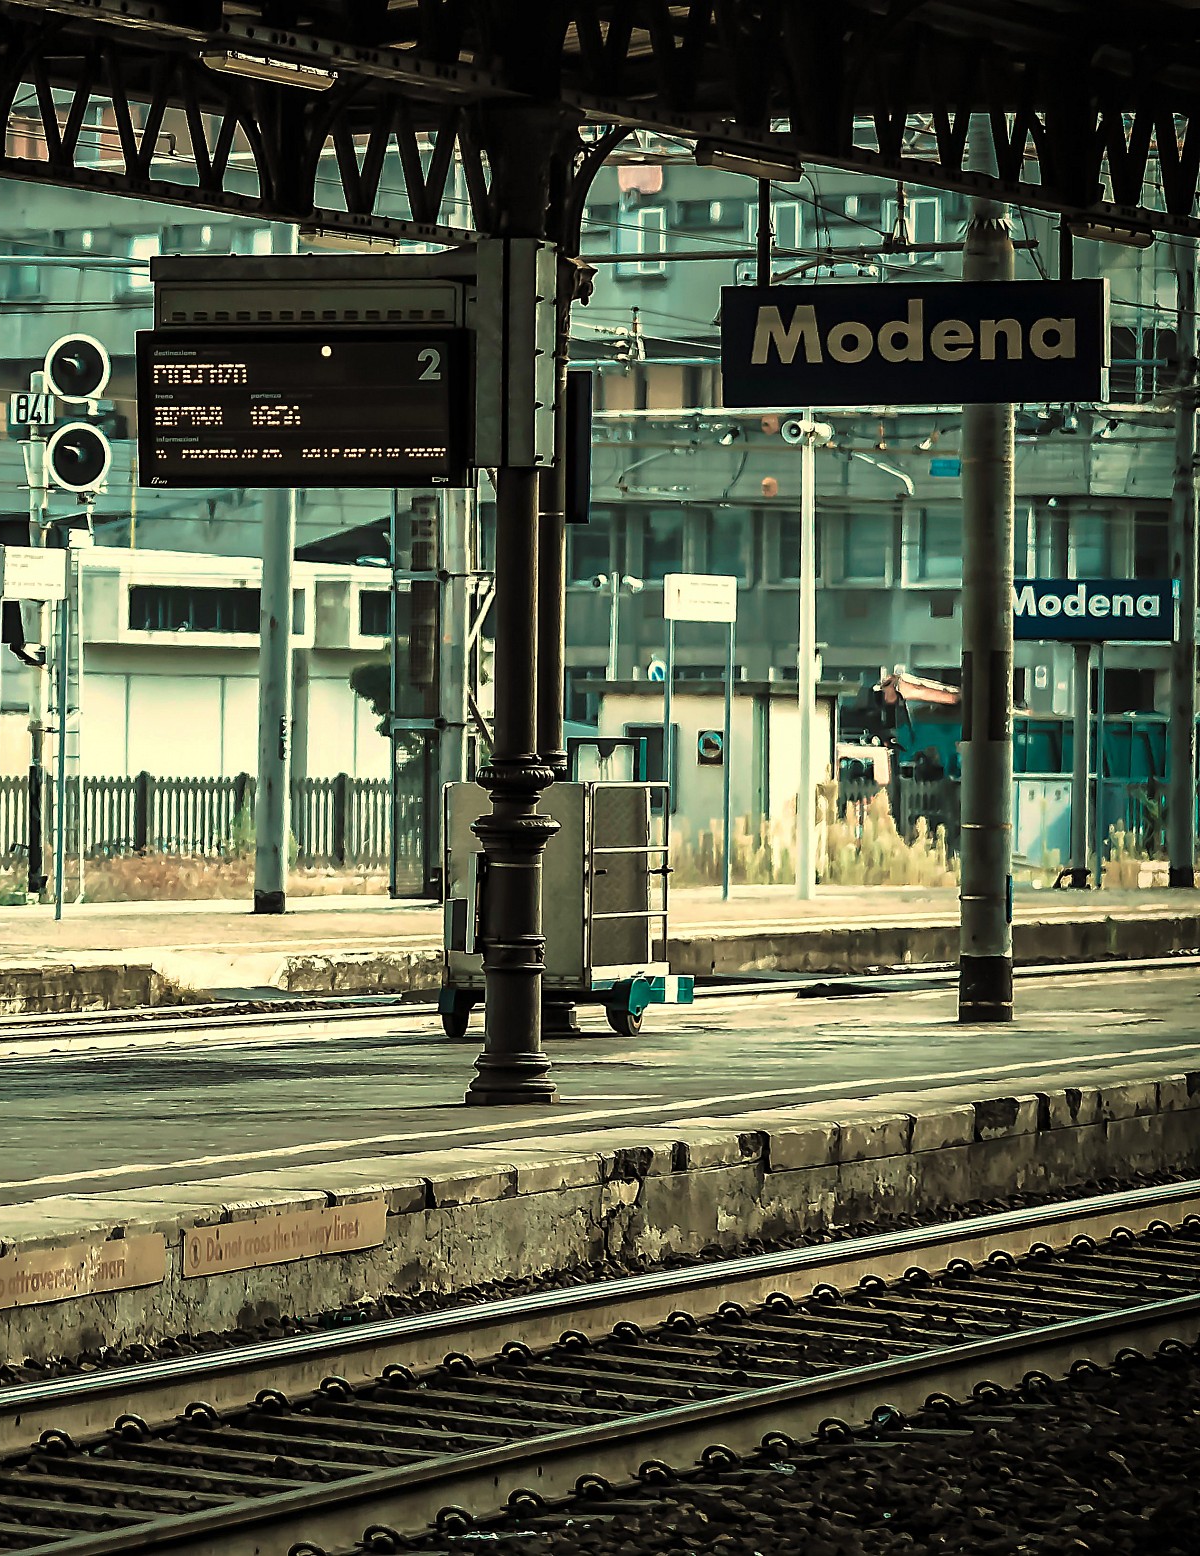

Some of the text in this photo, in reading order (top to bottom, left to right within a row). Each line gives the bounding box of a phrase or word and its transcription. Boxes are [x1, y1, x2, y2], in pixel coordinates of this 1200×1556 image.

[751, 298, 1077, 365] Modena
[417, 348, 441, 381] 2
[16, 394, 49, 423] 841
[1012, 583, 1161, 618] Modena
[206, 1236, 223, 1262] Do
[224, 1235, 242, 1260] not
[244, 1234, 271, 1256] cross
[273, 1223, 290, 1251] the
